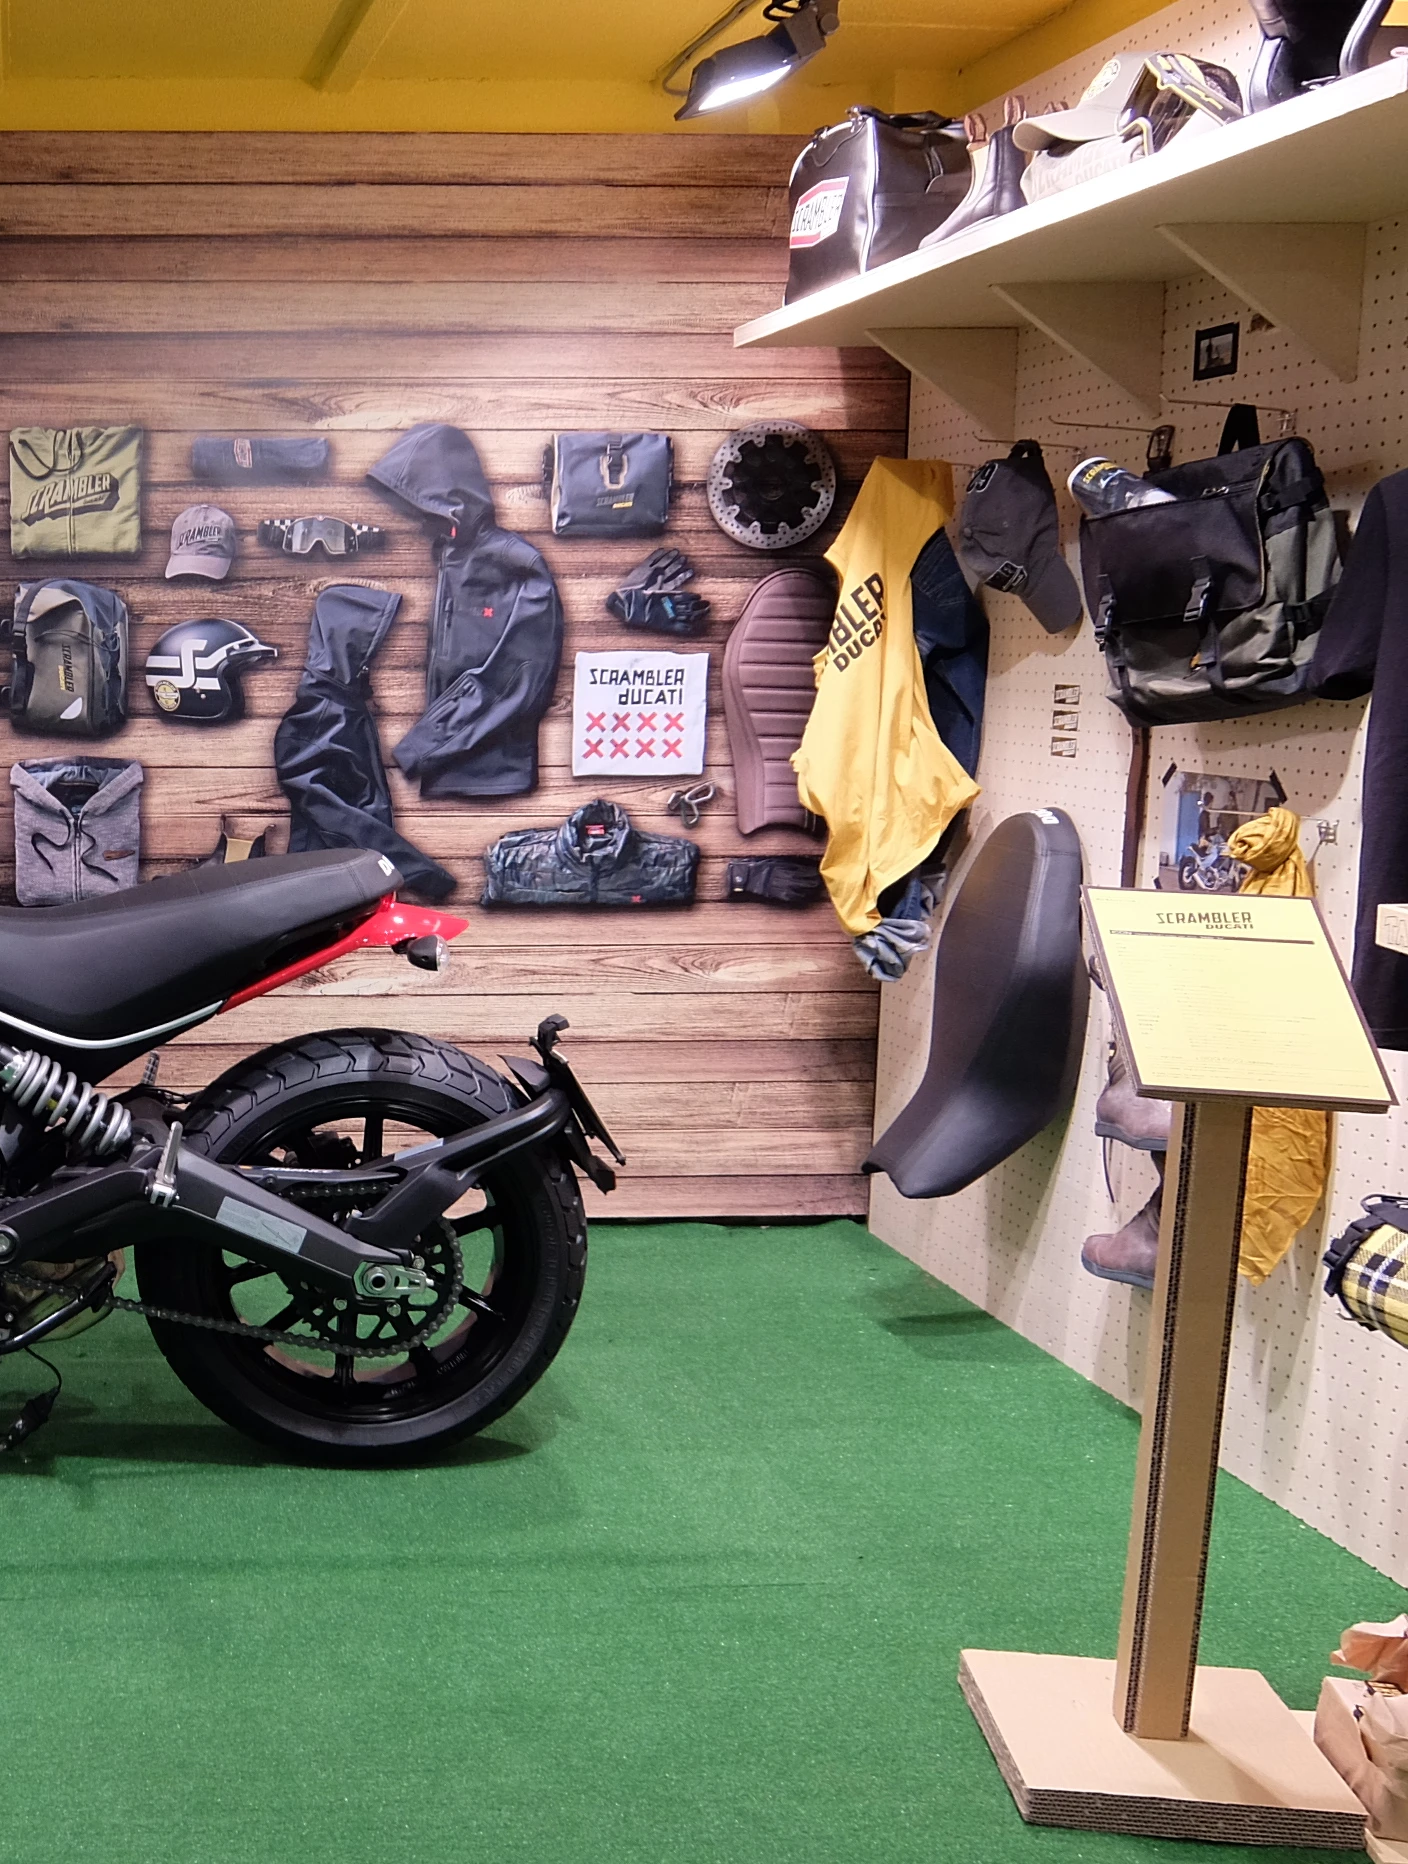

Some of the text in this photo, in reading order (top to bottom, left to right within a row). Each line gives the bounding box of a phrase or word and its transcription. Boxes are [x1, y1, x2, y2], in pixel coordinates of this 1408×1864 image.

[20, 473, 112, 521] SCRAMBLER
[829, 571, 884, 655] BLER
[833, 612, 886, 672] DUCA
[589, 668, 685, 686] SCRAMBLER
[1156, 911, 1253, 925] SCRAMBLER
